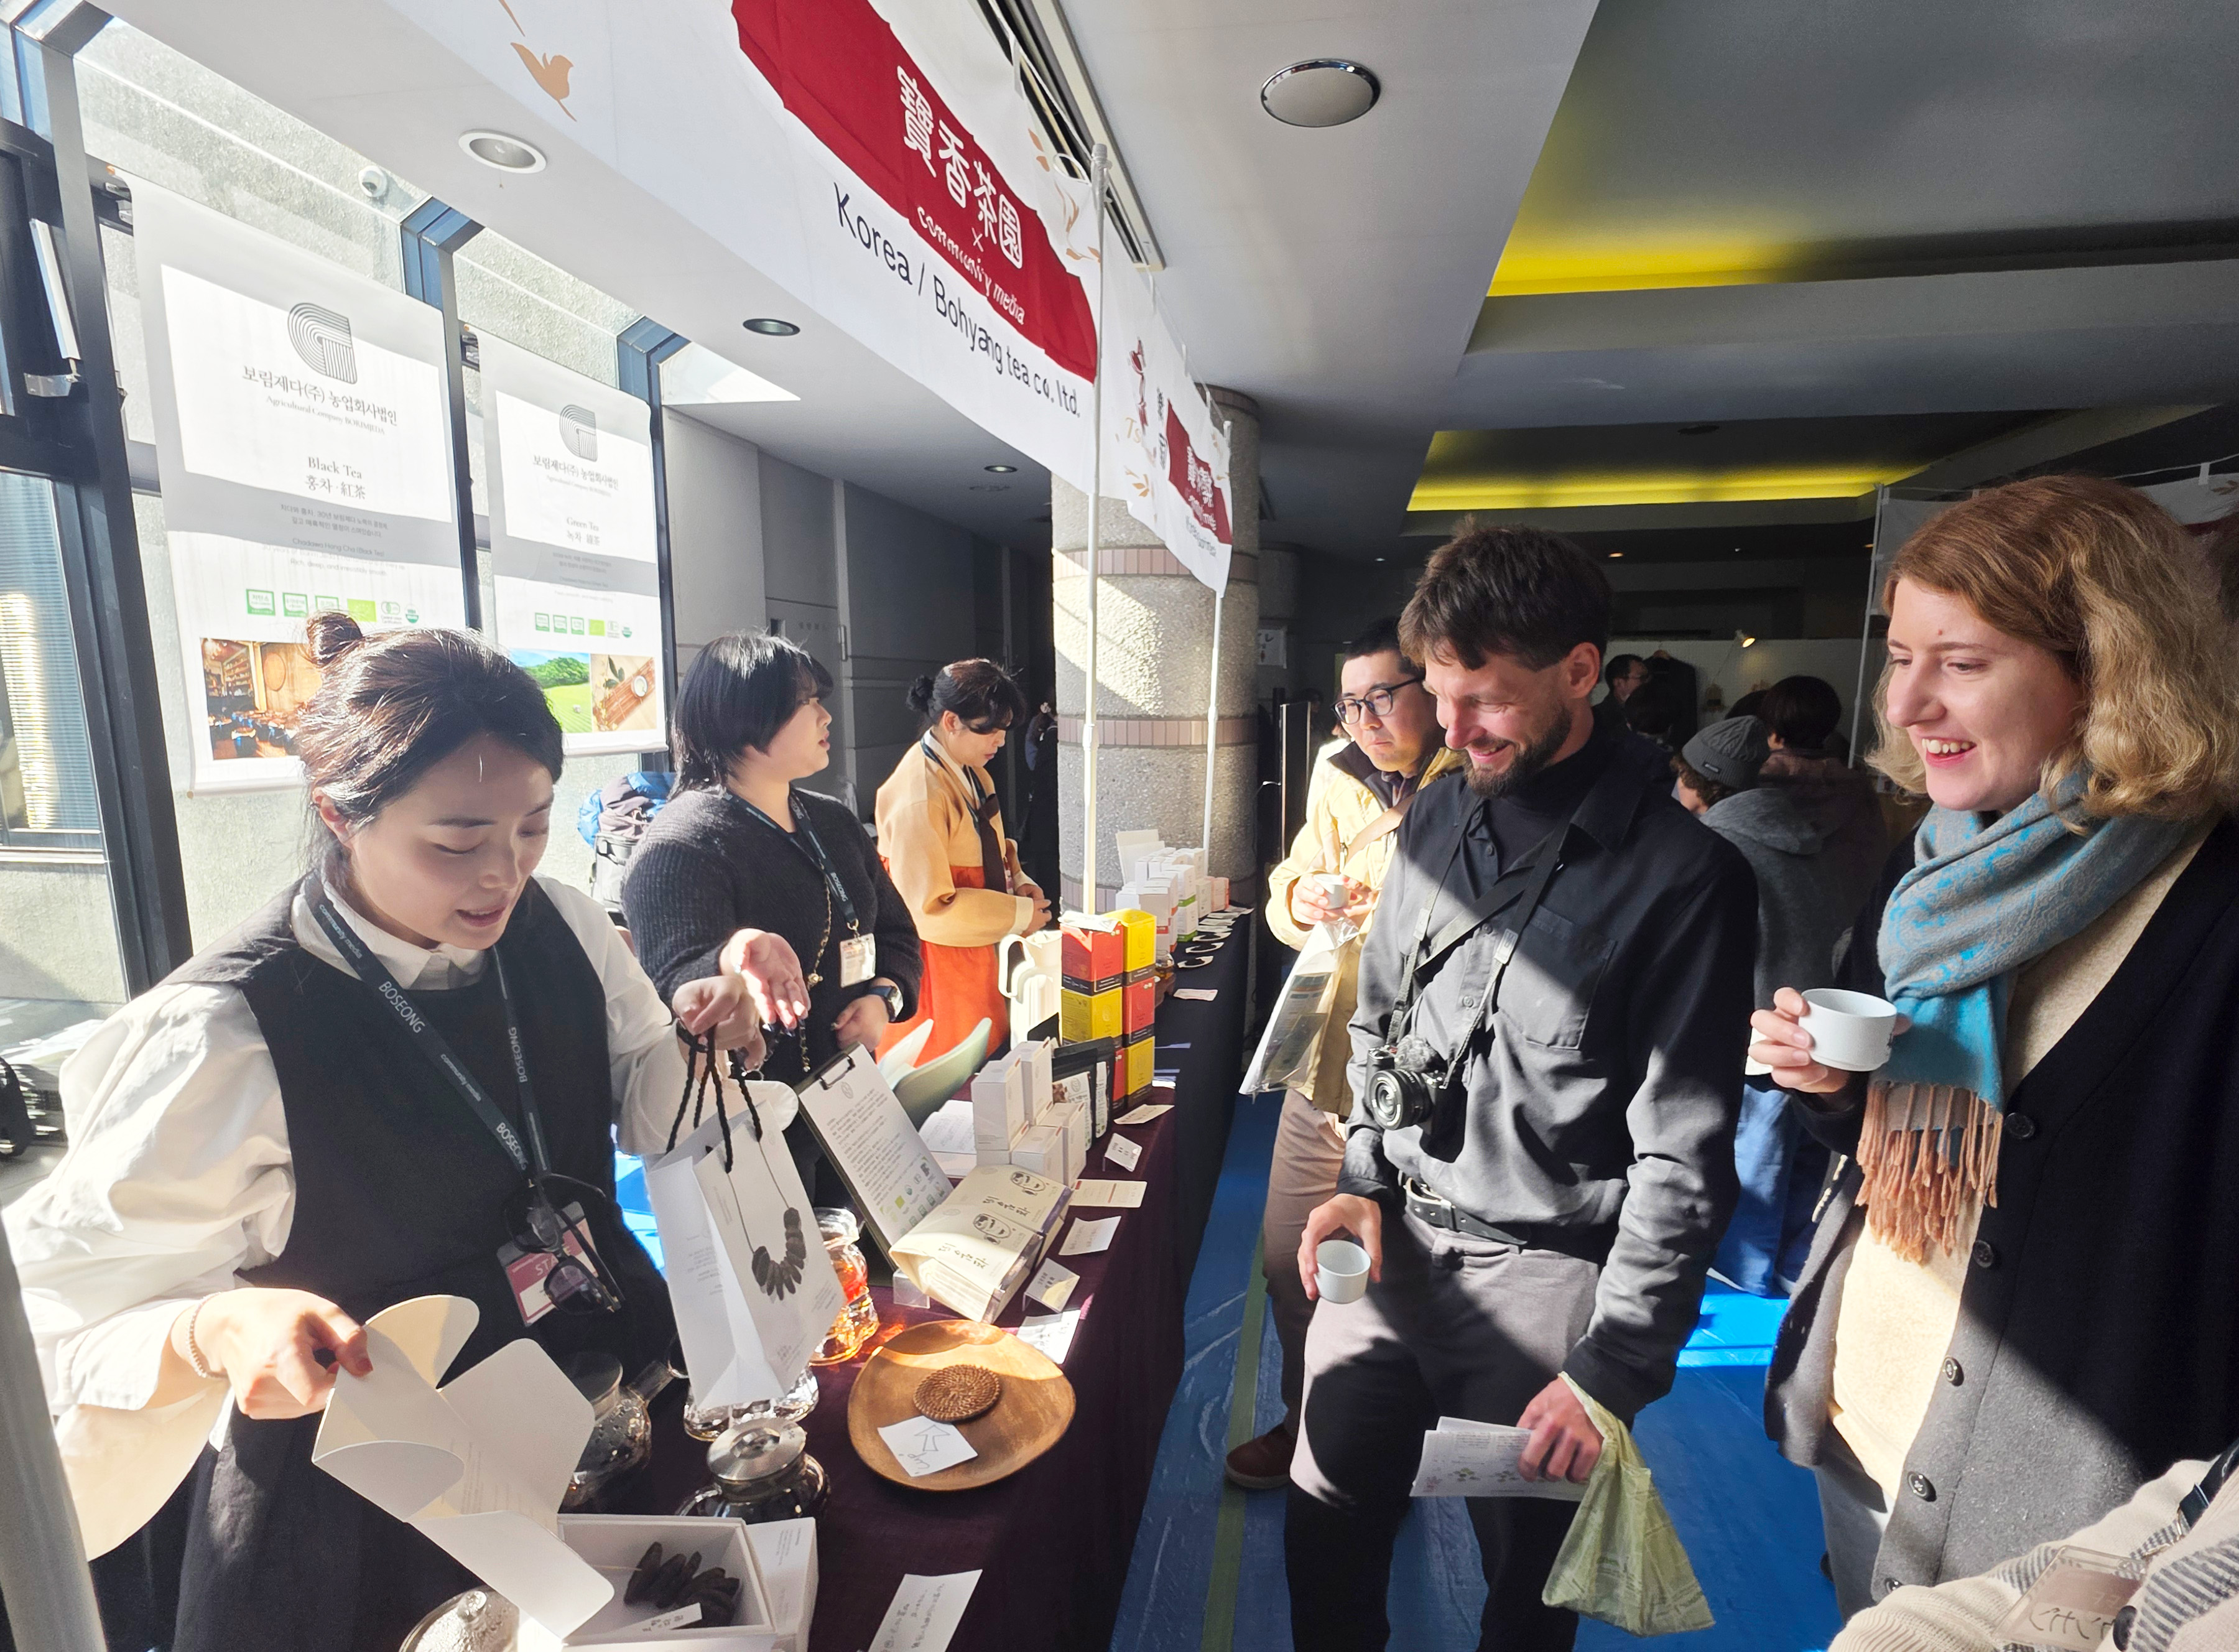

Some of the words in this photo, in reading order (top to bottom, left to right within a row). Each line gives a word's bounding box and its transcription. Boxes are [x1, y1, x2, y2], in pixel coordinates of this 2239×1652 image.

[897, 65, 1022, 269] 寶香茶園
[834, 182, 913, 285] Korea
[934, 274, 1003, 376] Bohyang
[1006, 346, 1030, 386] tea
[1034, 373, 1055, 403] co.
[917, 206, 991, 296] community
[994, 281, 1026, 325] media
[242, 366, 325, 404] 보림제다(주)
[328, 391, 397, 427] 농업회사법인
[266, 396, 311, 414] Agricultural
[312, 409, 343, 423] Company
[345, 417, 385, 435] BORIMJEDA
[305, 475, 333, 494] 홍차
[308, 457, 340, 474] Black
[343, 465, 362, 479] Tea
[567, 517, 587, 529] Green
[319, 904, 346, 939] community
[345, 939, 362, 959] media
[378, 981, 426, 1034] BOSEONG
[508, 1027, 528, 1083] BOSEONG
[535, 1245, 572, 1276] STAF
